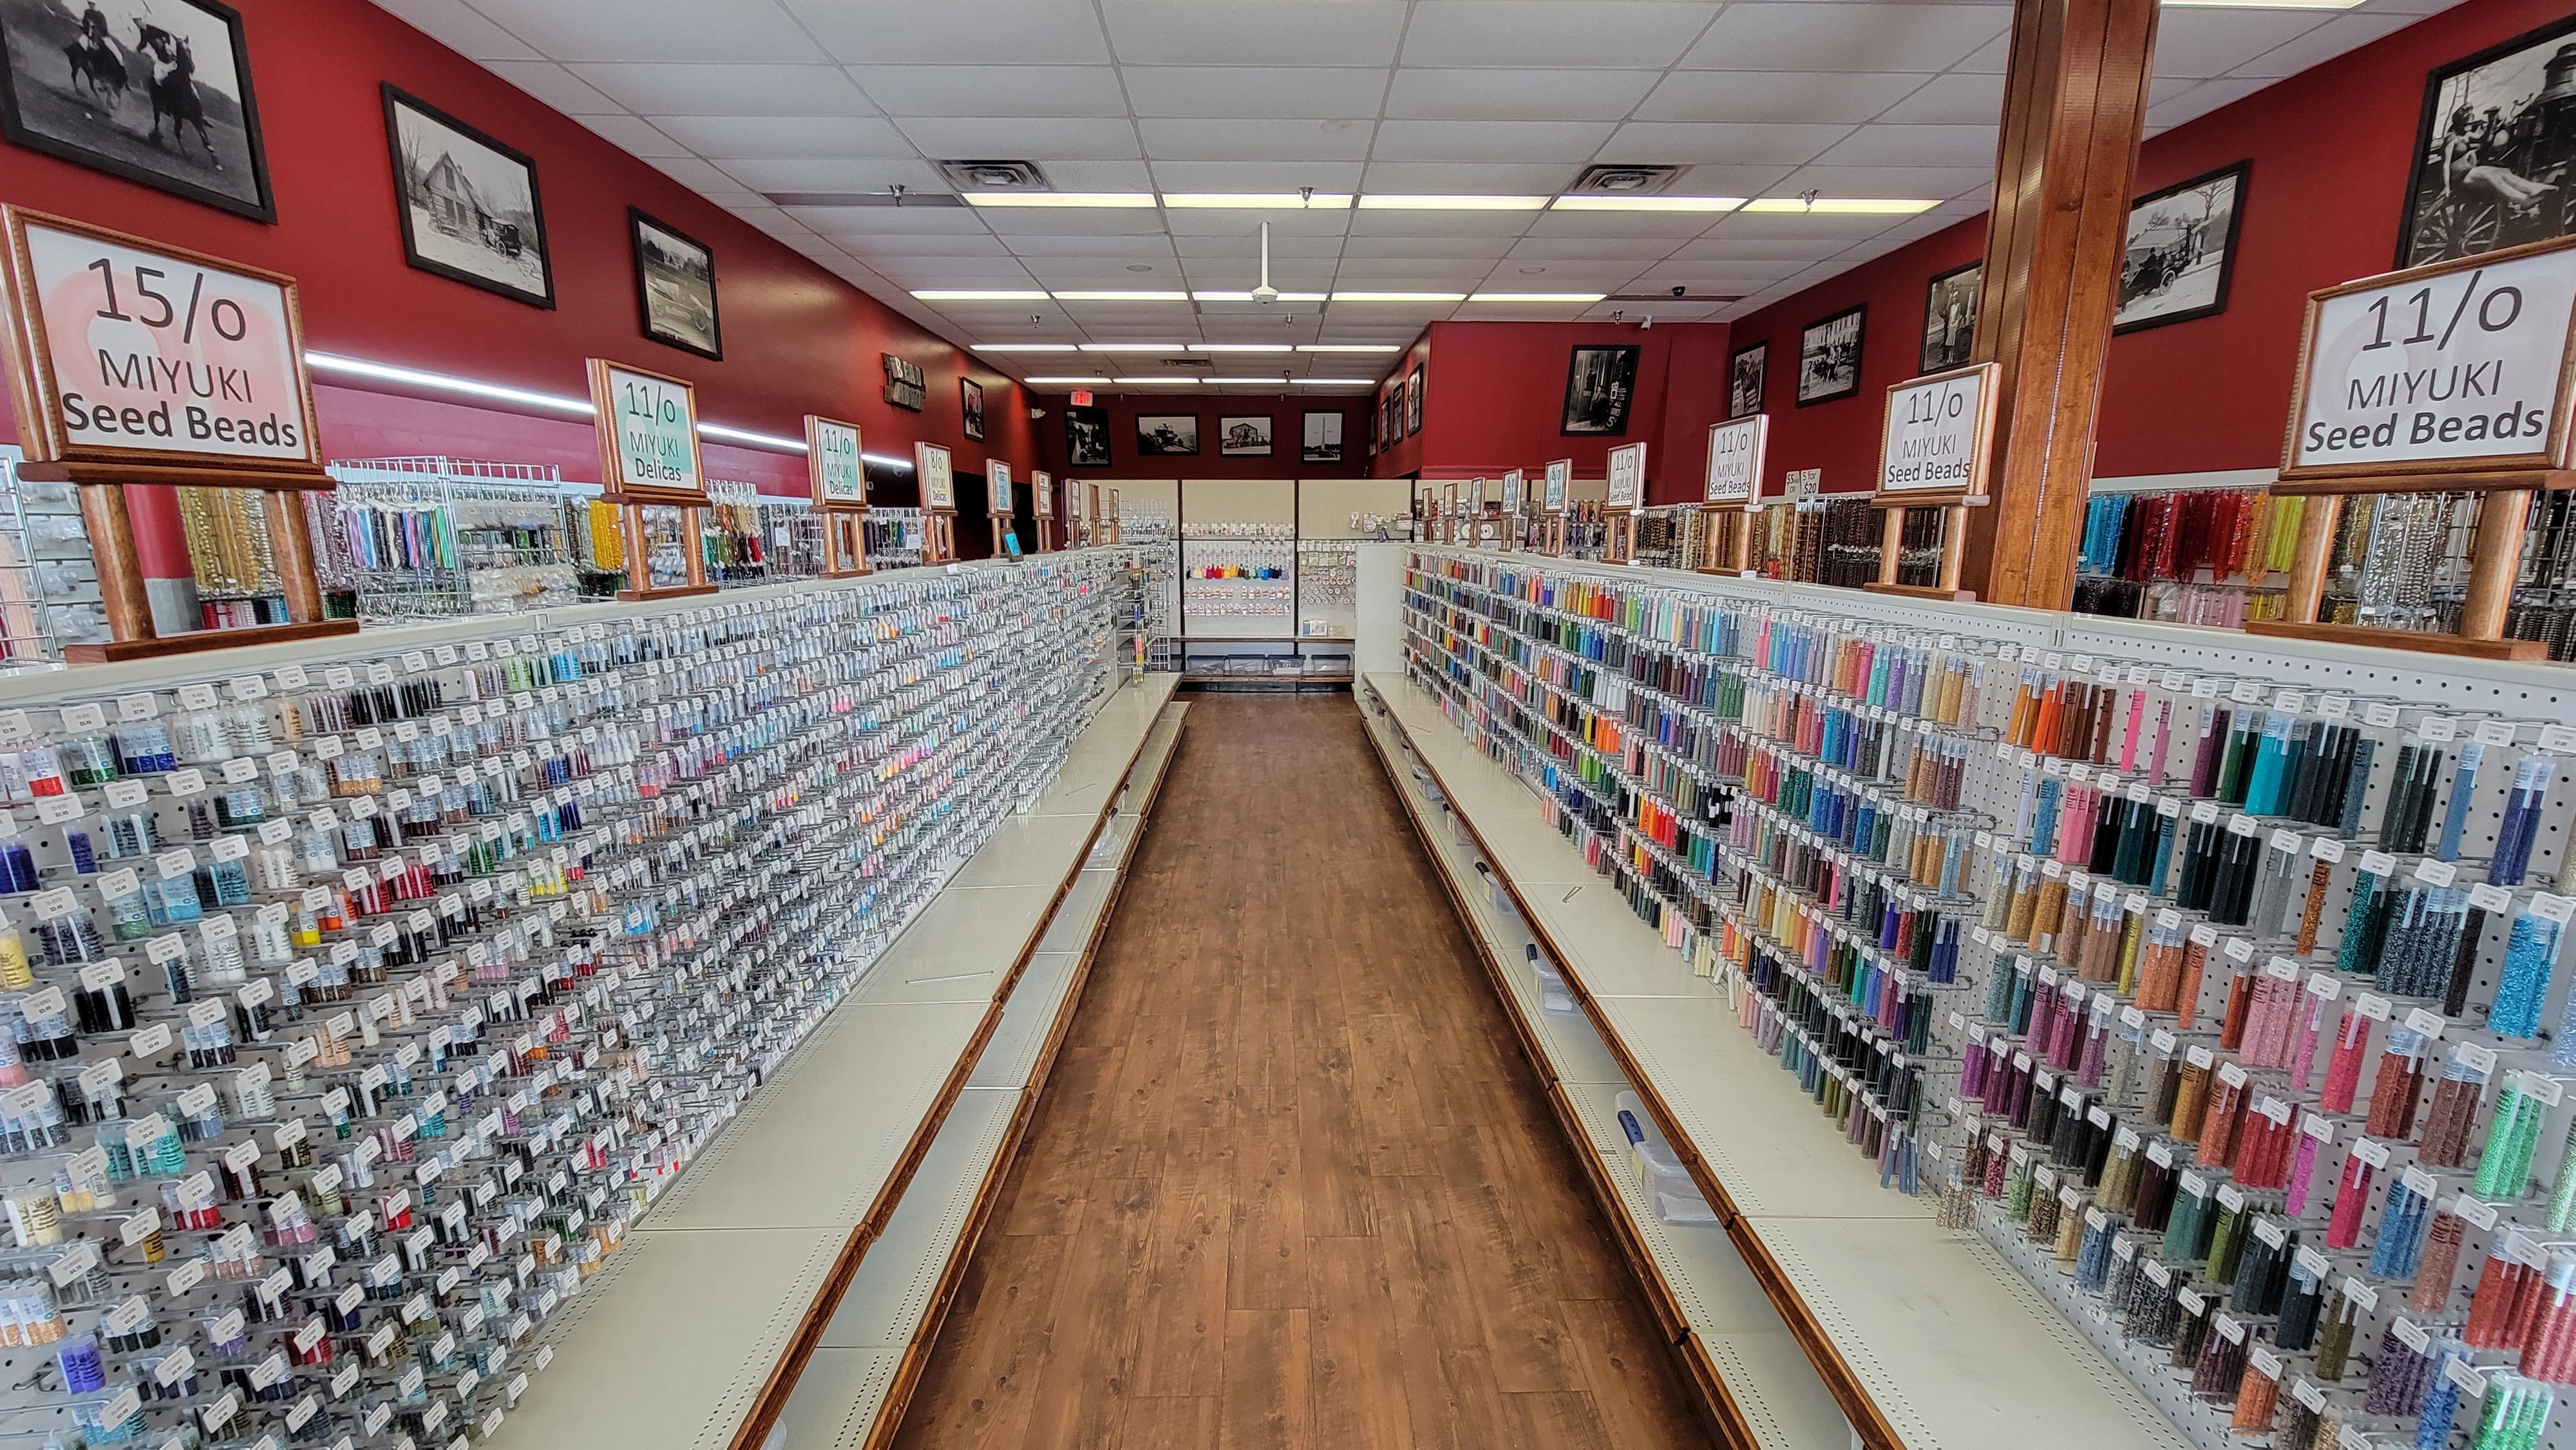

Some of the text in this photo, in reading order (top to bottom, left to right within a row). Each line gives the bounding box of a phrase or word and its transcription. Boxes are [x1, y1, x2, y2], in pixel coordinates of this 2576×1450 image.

[99, 348, 252, 403] MIYUKI
[2347, 360, 2503, 410] MIYUKI
[62, 392, 298, 447] Seed Beads
[2306, 401, 2544, 452] Seed Beads
[629, 431, 679, 458] MIYUKI
[1902, 434, 1956, 459] MIYUKI
[635, 458, 681, 482] Delicas
[827, 462, 852, 479] MIYUKI
[1717, 462, 1745, 478] MIYUKI
[1786, 473, 1794, 486] $5
[1808, 471, 1816, 480] for
[1888, 457, 1971, 483] Seed Beads
[829, 480, 853, 496] Delicas
[1609, 492, 1620, 502] Seed
[1710, 482, 1727, 495] Seed
[1804, 482, 1816, 495] $20
